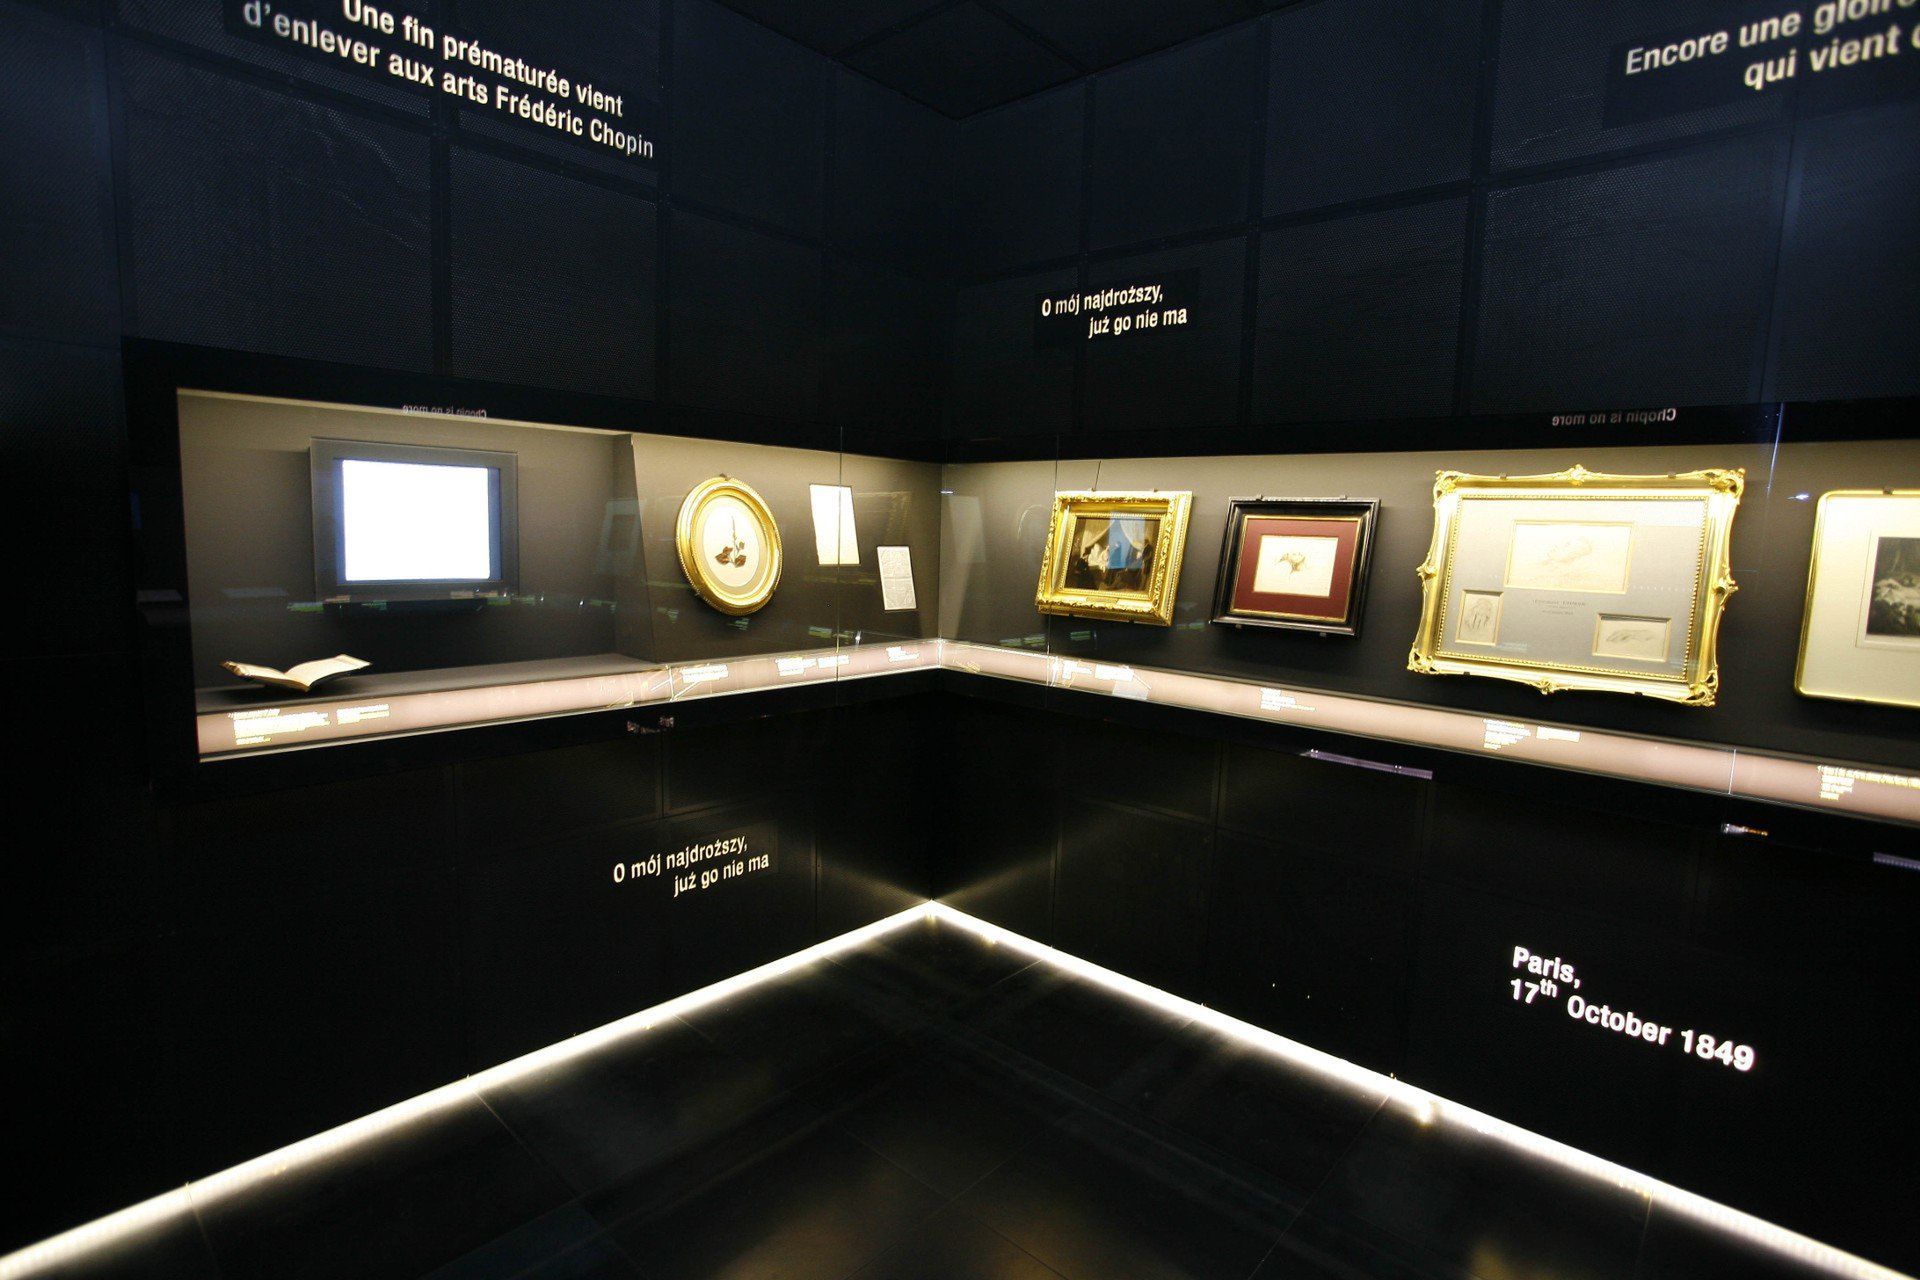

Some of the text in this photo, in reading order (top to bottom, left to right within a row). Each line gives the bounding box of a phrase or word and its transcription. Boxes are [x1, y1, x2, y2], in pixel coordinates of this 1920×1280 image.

[342, 0, 623, 118] Une fin prématurée vient
[1625, 30, 1730, 75] Encore
[1738, 12, 1802, 48] une
[1743, 49, 1797, 91] qui
[1809, 25, 1901, 72] vient
[244, 1, 654, 158] d’enlever aux arts Frédéric Chopin
[1041, 284, 1164, 317] O mój najdroższy,
[1088, 308, 1188, 339] już go nie ma
[613, 835, 748, 884] O mój najdroższy,
[673, 853, 770, 898] już go nie ma
[1512, 945, 1581, 990] Paris,
[1510, 977, 1756, 1072] 17th October 1849
